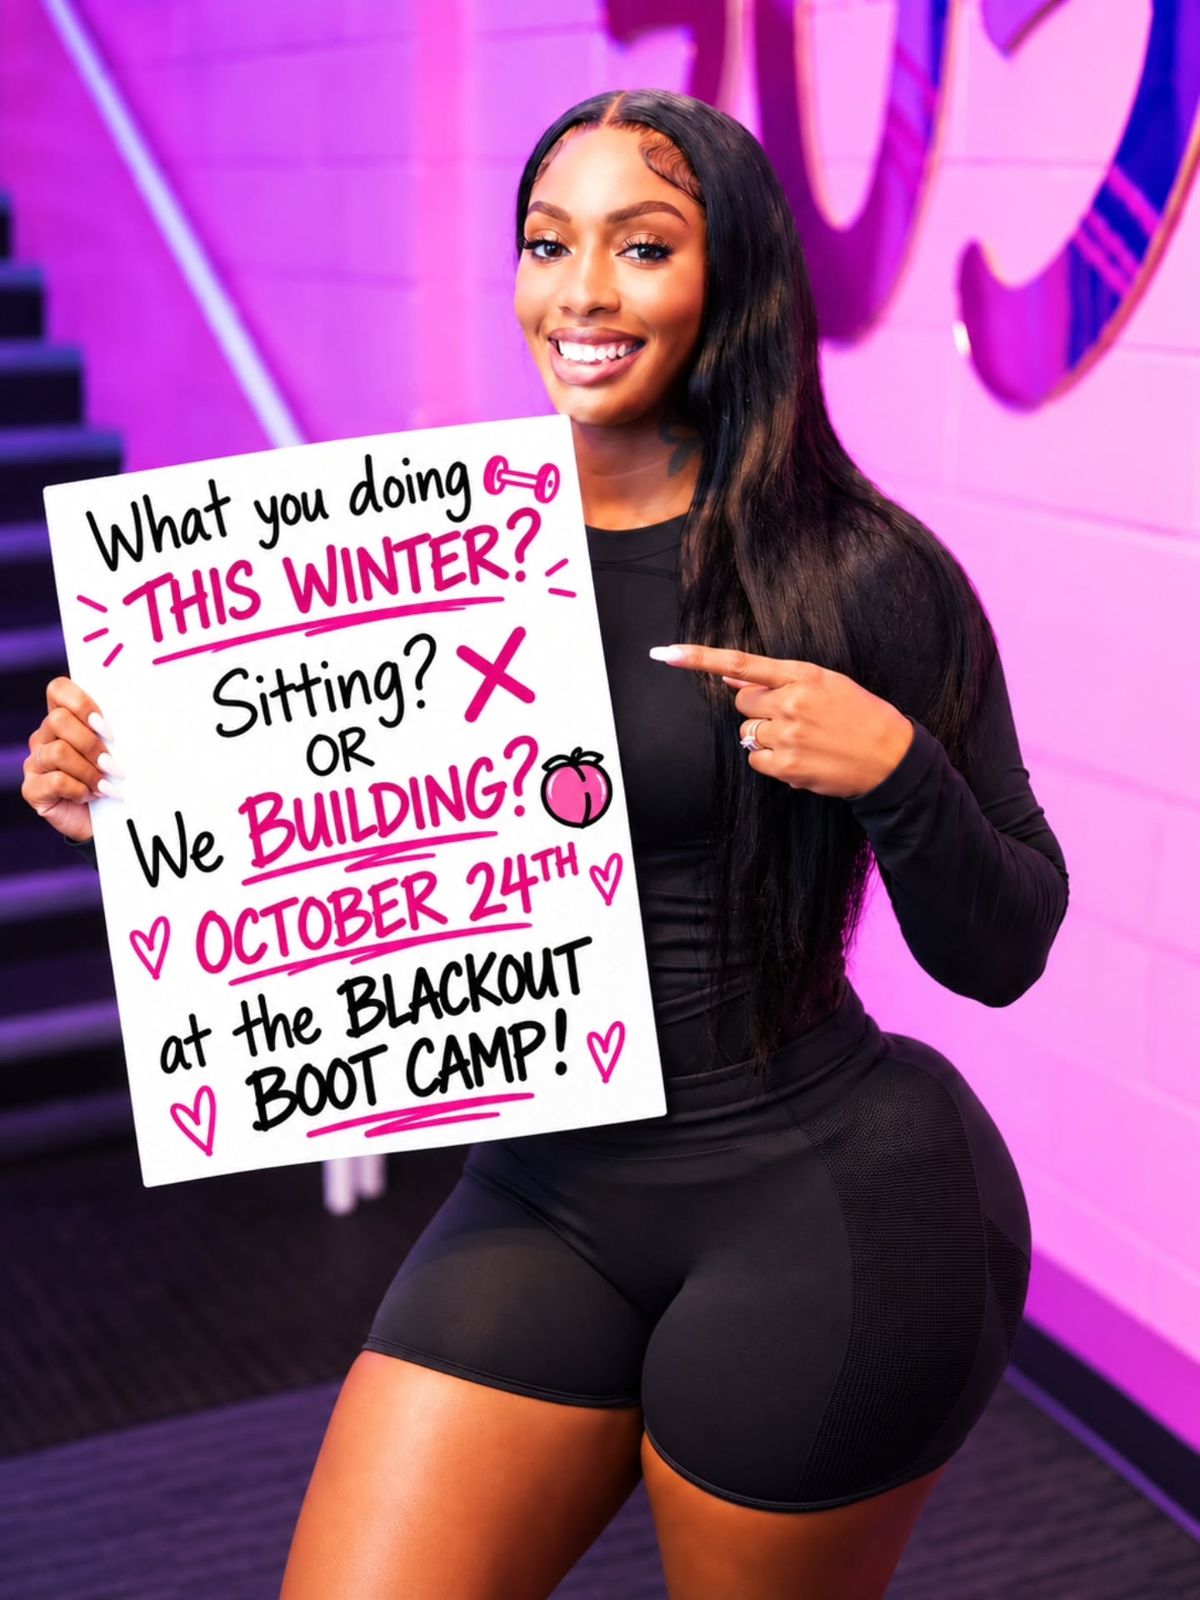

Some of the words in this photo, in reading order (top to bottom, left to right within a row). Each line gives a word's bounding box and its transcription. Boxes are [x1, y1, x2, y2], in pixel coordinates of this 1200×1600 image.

[86, 478, 232, 572] What
[253, 488, 330, 550] you
[349, 453, 472, 524] doing
[123, 559, 262, 643] THIS
[281, 506, 542, 614] WINTER?
[212, 632, 437, 739] Sitting?
[126, 810, 225, 889] We
[238, 734, 539, 870] BUILDING?
[306, 726, 376, 777] OR
[195, 870, 449, 975] OCTOBER
[465, 841, 580, 922] 24TH
[159, 1013, 213, 1075] at
[231, 993, 322, 1058] the
[336, 935, 593, 1039] BLACKOUT
[244, 1043, 389, 1133] BOOT
[405, 1007, 569, 1098] CAMP!
